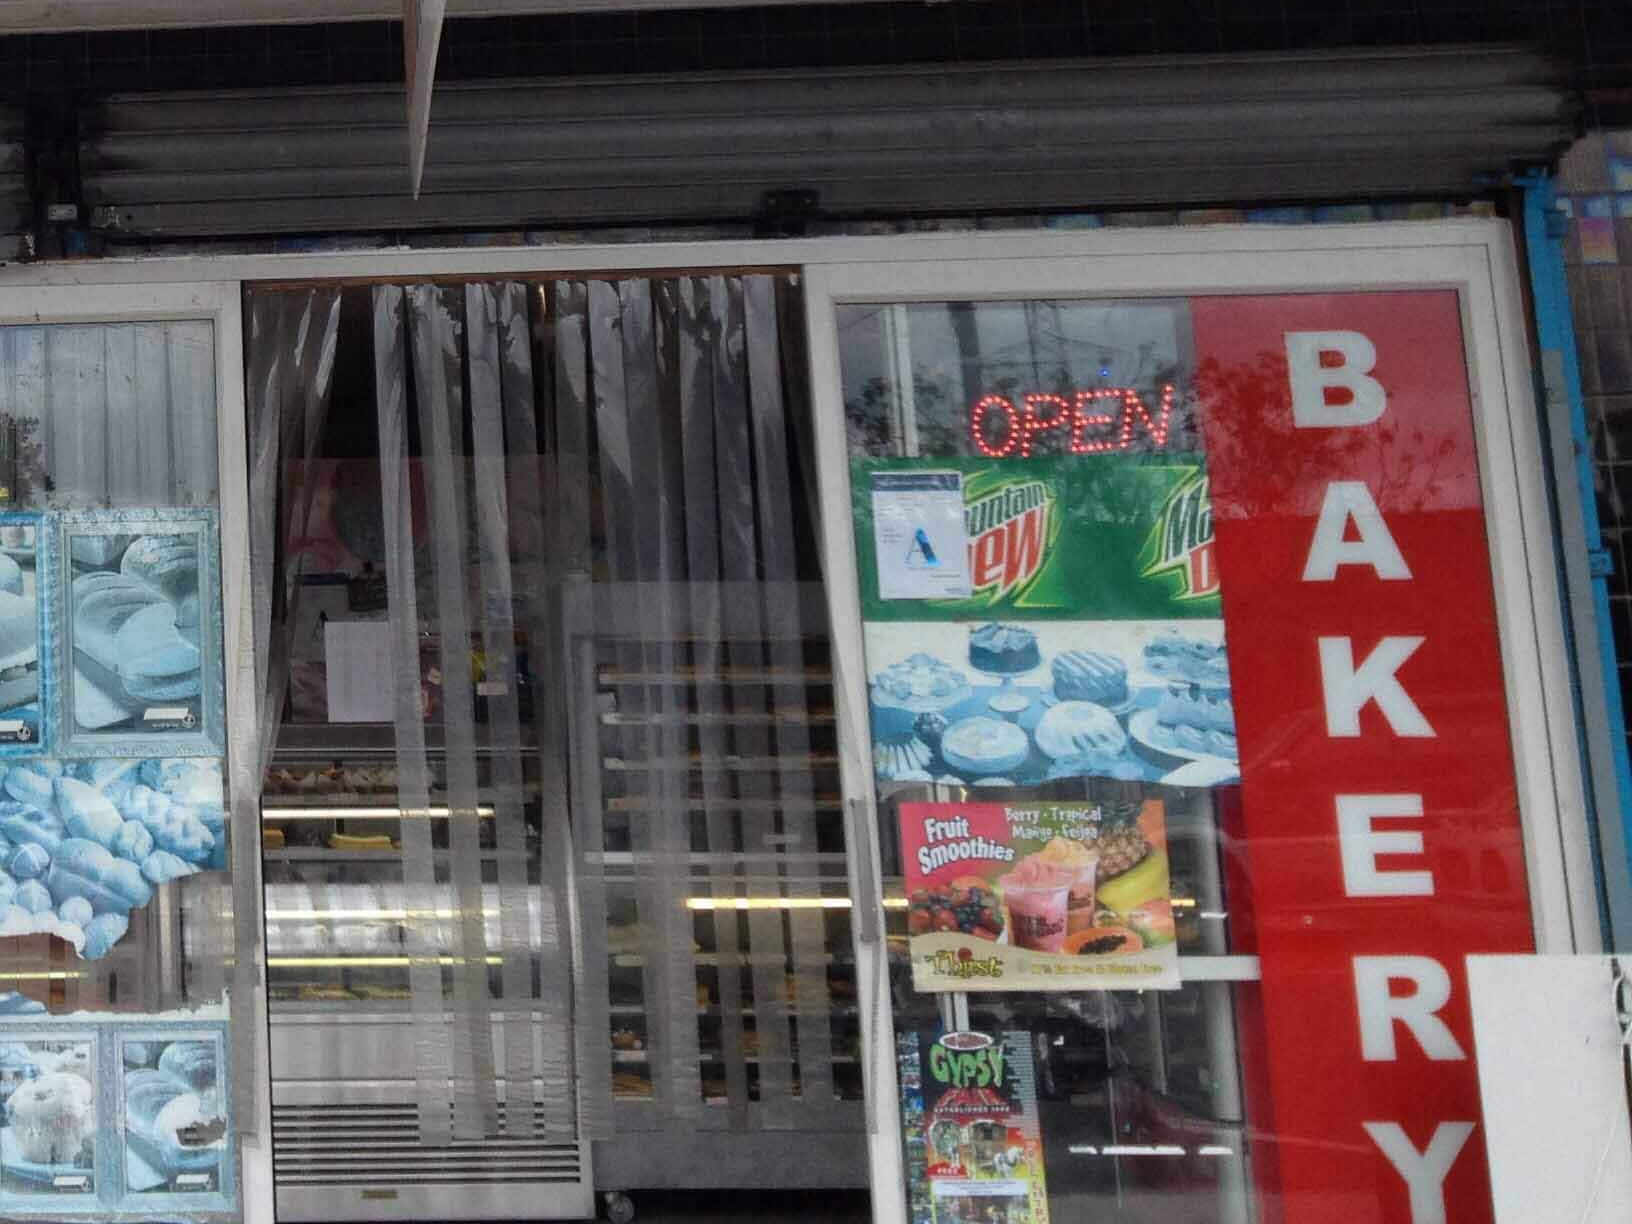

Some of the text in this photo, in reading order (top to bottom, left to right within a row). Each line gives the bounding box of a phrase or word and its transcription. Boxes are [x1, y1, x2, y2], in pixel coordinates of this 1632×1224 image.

[972, 384, 1175, 457] OPEN
[1284, 330, 1476, 1224] BAKERY
[918, 837, 1015, 875] Smoothies
[924, 816, 970, 843] Fruit
